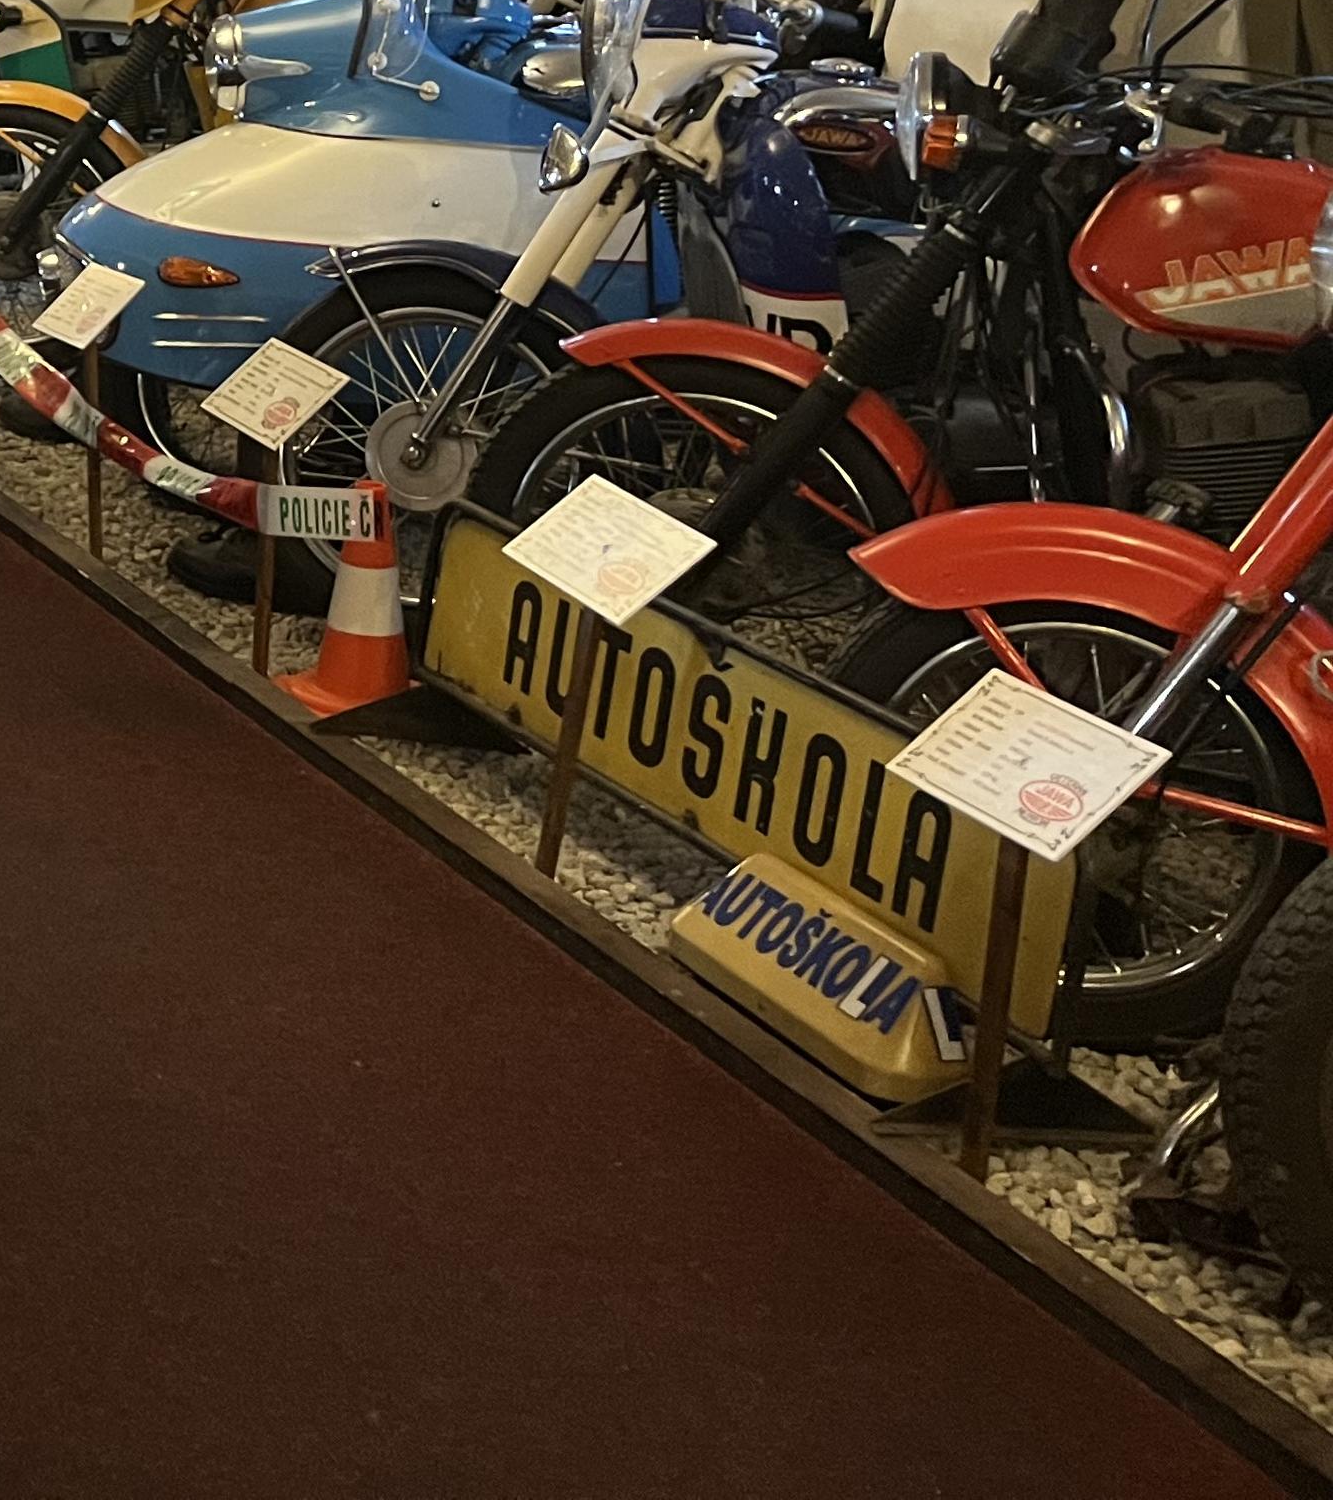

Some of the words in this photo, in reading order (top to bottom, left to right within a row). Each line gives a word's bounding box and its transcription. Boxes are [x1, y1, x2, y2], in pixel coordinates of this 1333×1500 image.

[1153, 236, 1312, 304] JAWA
[278, 496, 352, 537] POLICIE
[502, 579, 953, 933] AUTOŠKOLA
